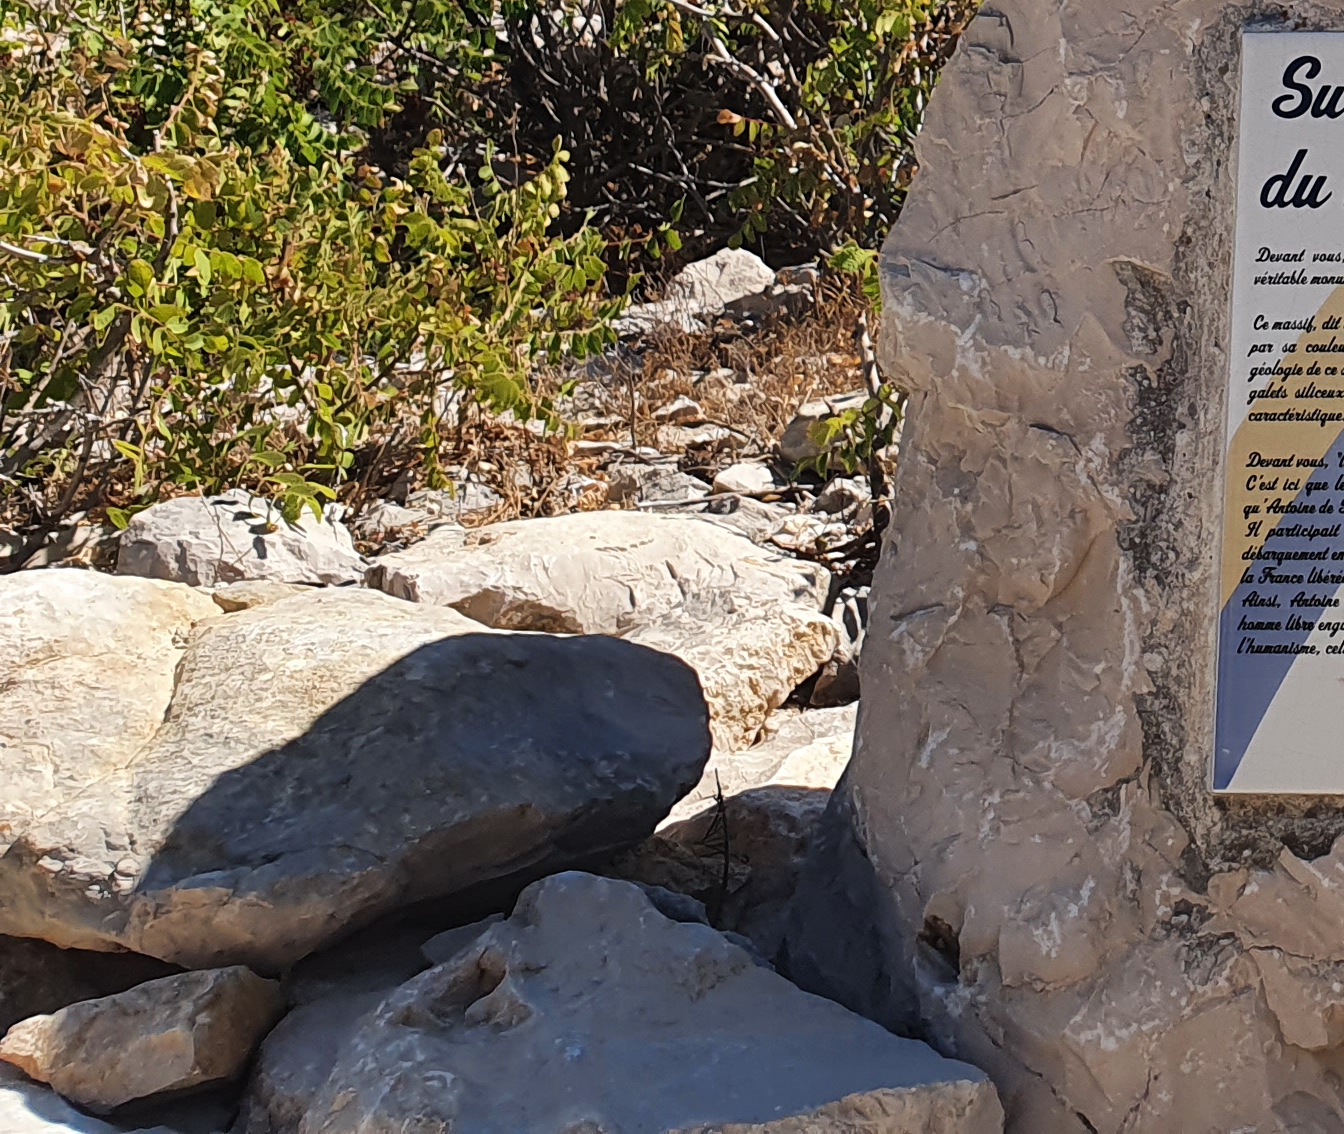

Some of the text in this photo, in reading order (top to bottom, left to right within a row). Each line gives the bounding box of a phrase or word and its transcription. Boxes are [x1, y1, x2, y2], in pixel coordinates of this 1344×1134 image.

[1260, 149, 1332, 209] du
[1255, 247, 1305, 262] Devant
[1254, 268, 1307, 285] véritable
[1254, 315, 1269, 330] Ce
[1272, 315, 1317, 333] massif,
[1322, 315, 1342, 330] dit
[1247, 343, 1274, 357] par
[1247, 359, 1303, 381] géologie
[1306, 361, 1321, 375] de
[1247, 382, 1288, 405] galets
[1295, 382, 1344, 398] siliceux
[1246, 452, 1295, 467] Devant
[1296, 457, 1328, 469] vous,
[1246, 475, 1279, 491] C'est
[1283, 478, 1300, 491] ici
[1305, 482, 1329, 497] que
[1243, 498, 1316, 520] qu'Antoine
[1319, 499, 1334, 514] de
[1245, 520, 1263, 537] Il
[1265, 524, 1341, 541] participait
[1241, 545, 1330, 566] débarquement
[1239, 566, 1254, 584] la
[1258, 567, 1304, 584] France
[1242, 591, 1281, 608] Ainsi,
[1290, 591, 1339, 607] Antoine
[1237, 615, 1282, 631] homme
[1285, 614, 1314, 631] libre
[1237, 637, 1320, 656] l'humanisme,
